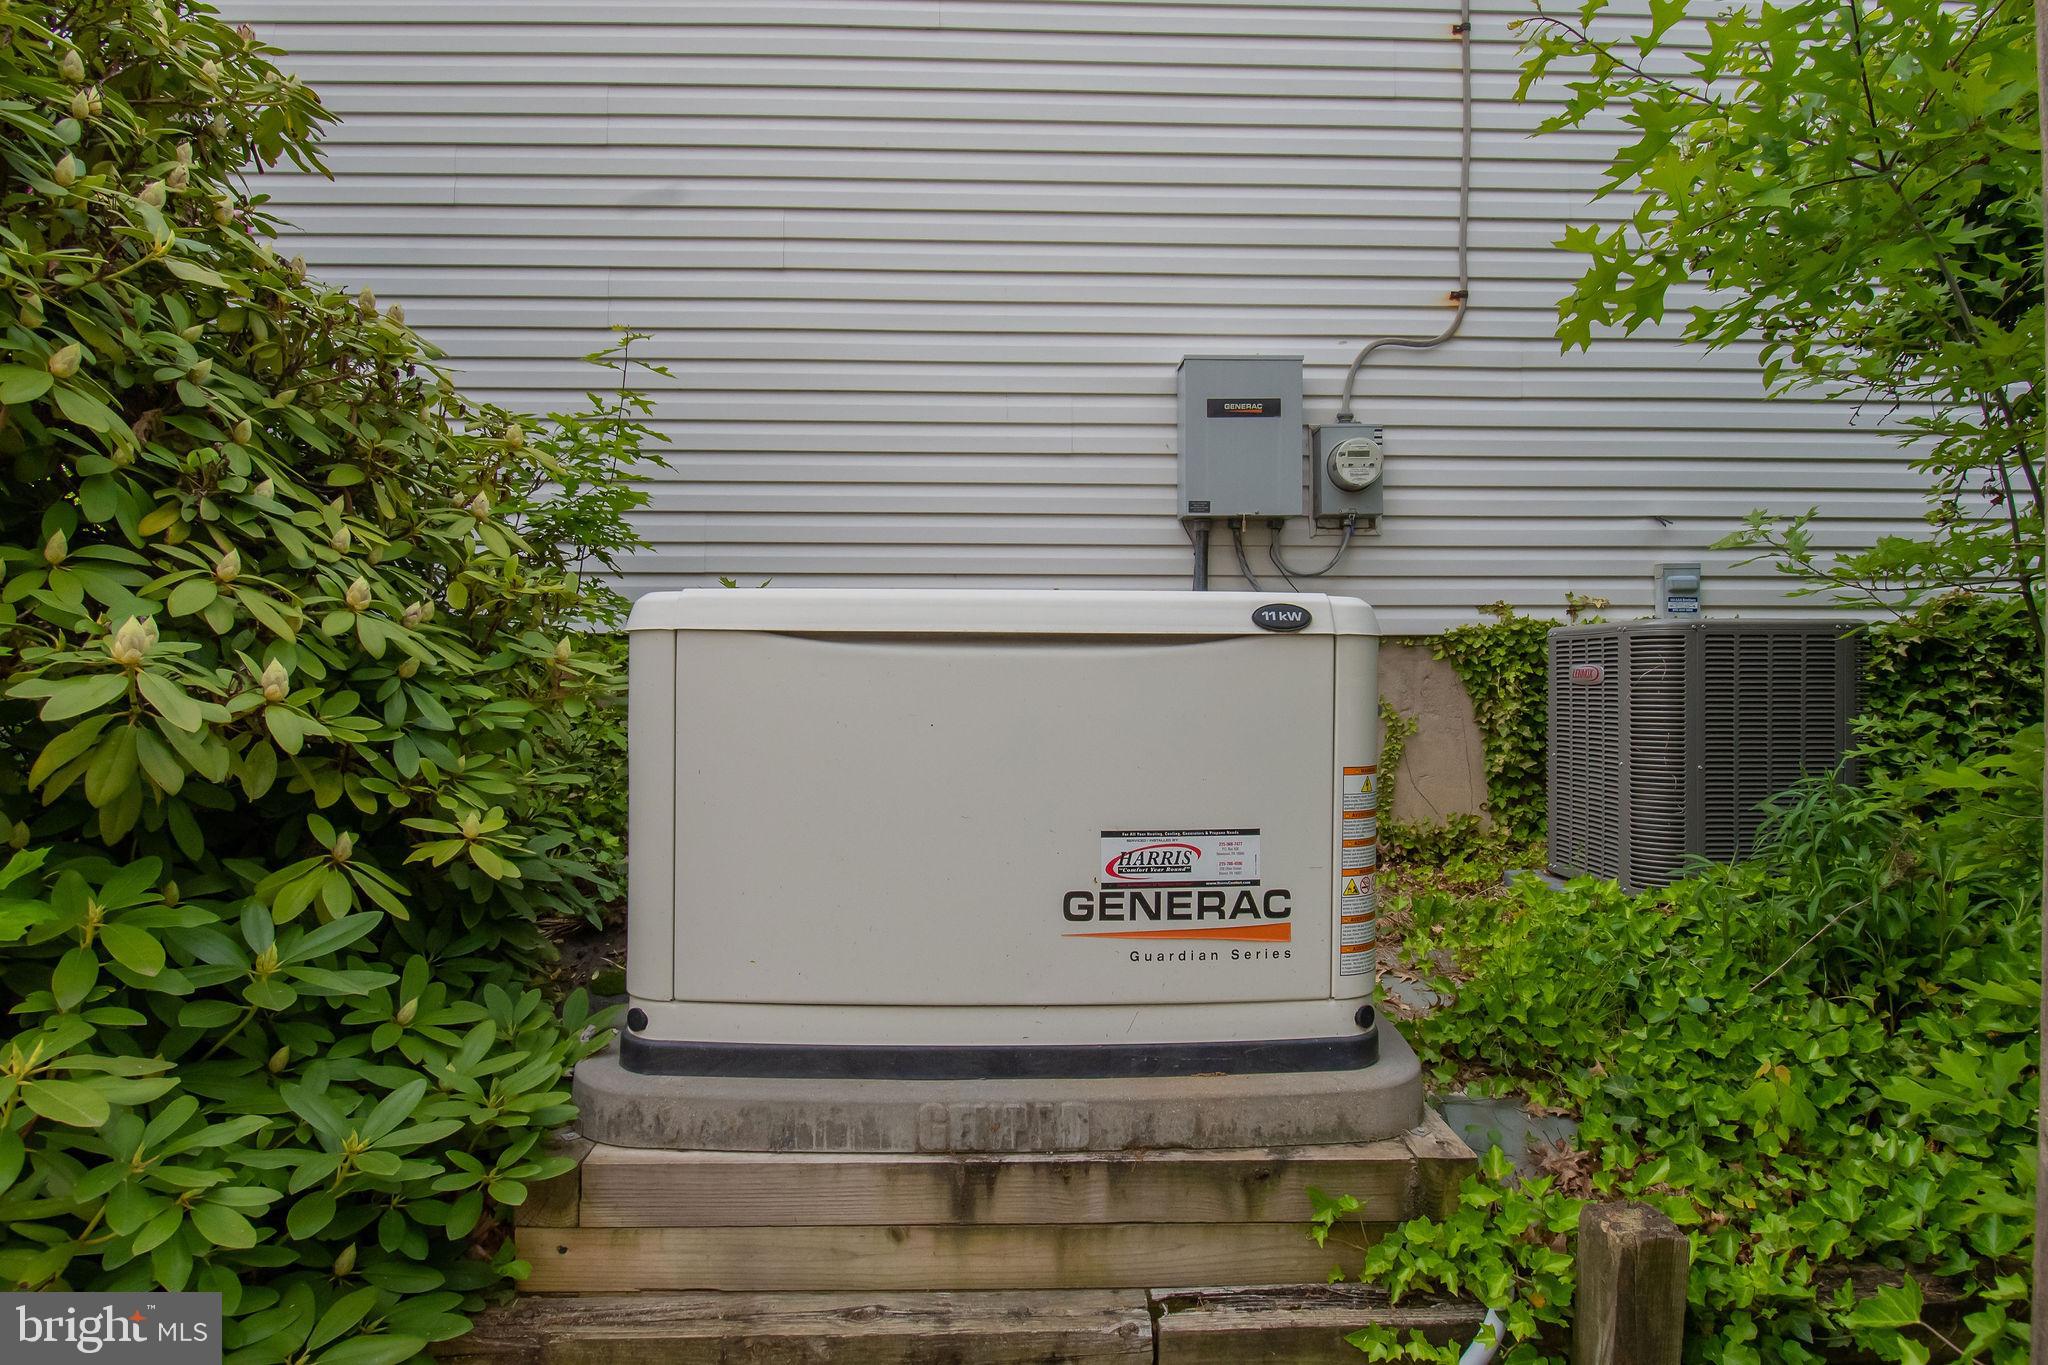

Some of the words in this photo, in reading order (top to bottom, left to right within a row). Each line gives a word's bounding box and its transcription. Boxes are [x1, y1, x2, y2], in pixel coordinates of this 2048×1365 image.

[1261, 611, 1277, 621] 11
[1279, 611, 1302, 621] kW
[1118, 850, 1192, 866] HARRIS
[1062, 889, 1292, 922] GENERAC
[1129, 950, 1219, 962] Guardian
[1231, 949, 1292, 960] Series
